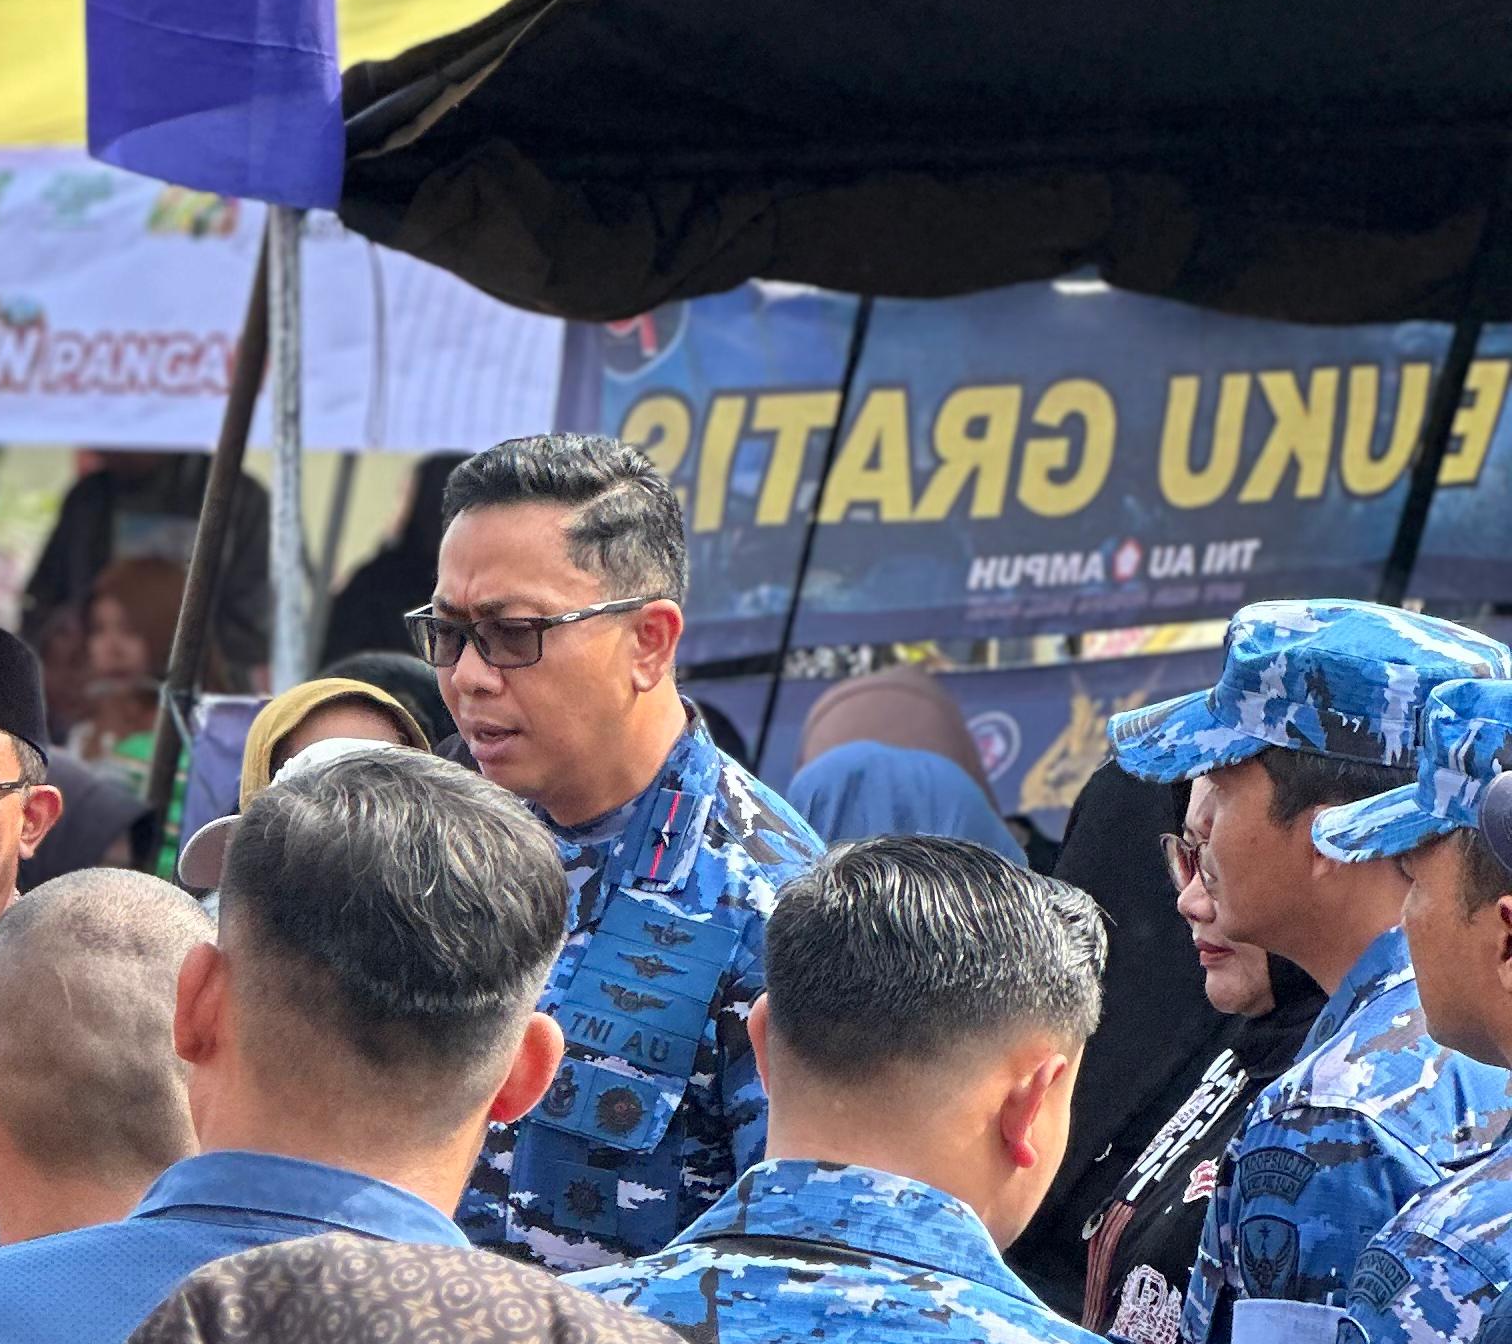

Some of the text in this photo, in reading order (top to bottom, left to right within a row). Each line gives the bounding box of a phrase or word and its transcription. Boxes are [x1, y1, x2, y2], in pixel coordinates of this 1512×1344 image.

[40, 328, 270, 396] PANGA
[569, 1011, 671, 1063] TNI AU
